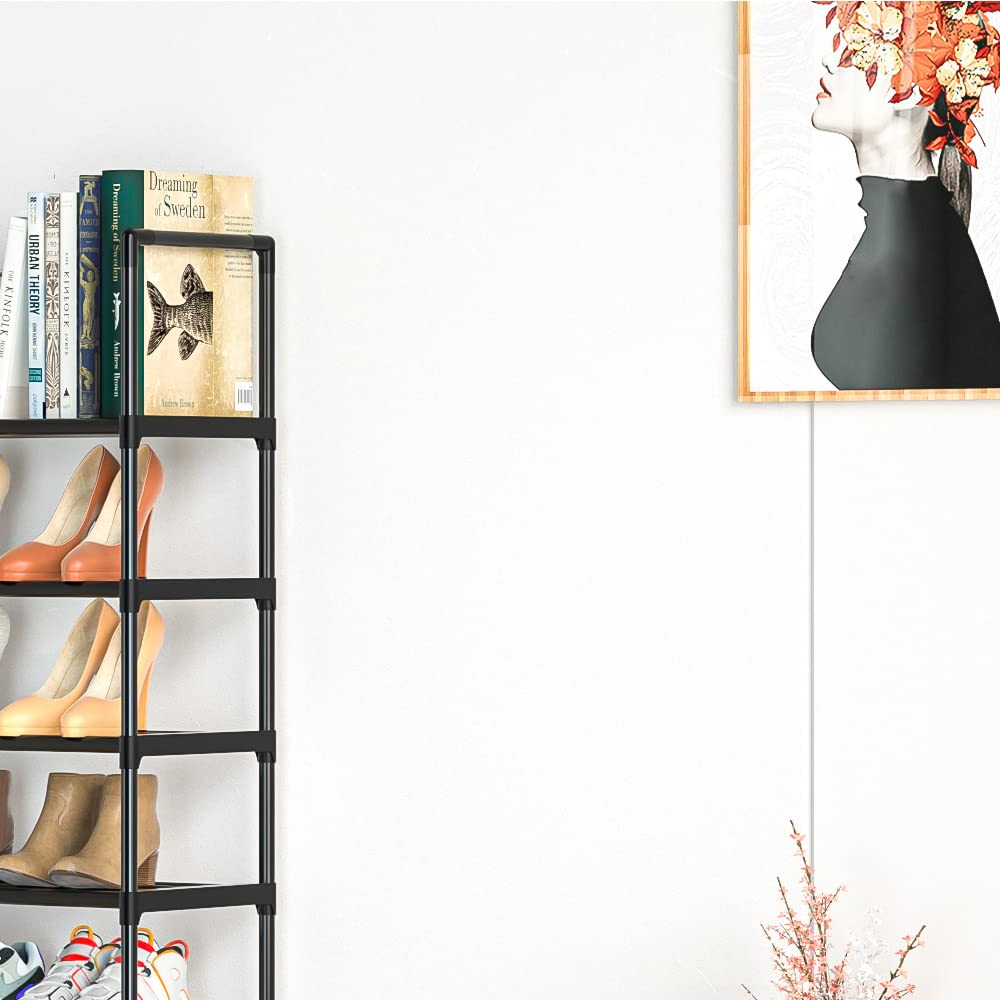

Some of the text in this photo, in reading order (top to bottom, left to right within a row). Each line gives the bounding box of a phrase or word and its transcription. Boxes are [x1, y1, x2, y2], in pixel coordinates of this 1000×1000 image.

[149, 170, 198, 198] Dreaming
[155, 195, 206, 219] of Sweden
[111, 183, 121, 282] Dreaming of Sweden
[28, 234, 41, 315] URBAN THEORY
[0, 286, 14, 337] KINFOLK
[113, 340, 121, 397] Andrew Brown
